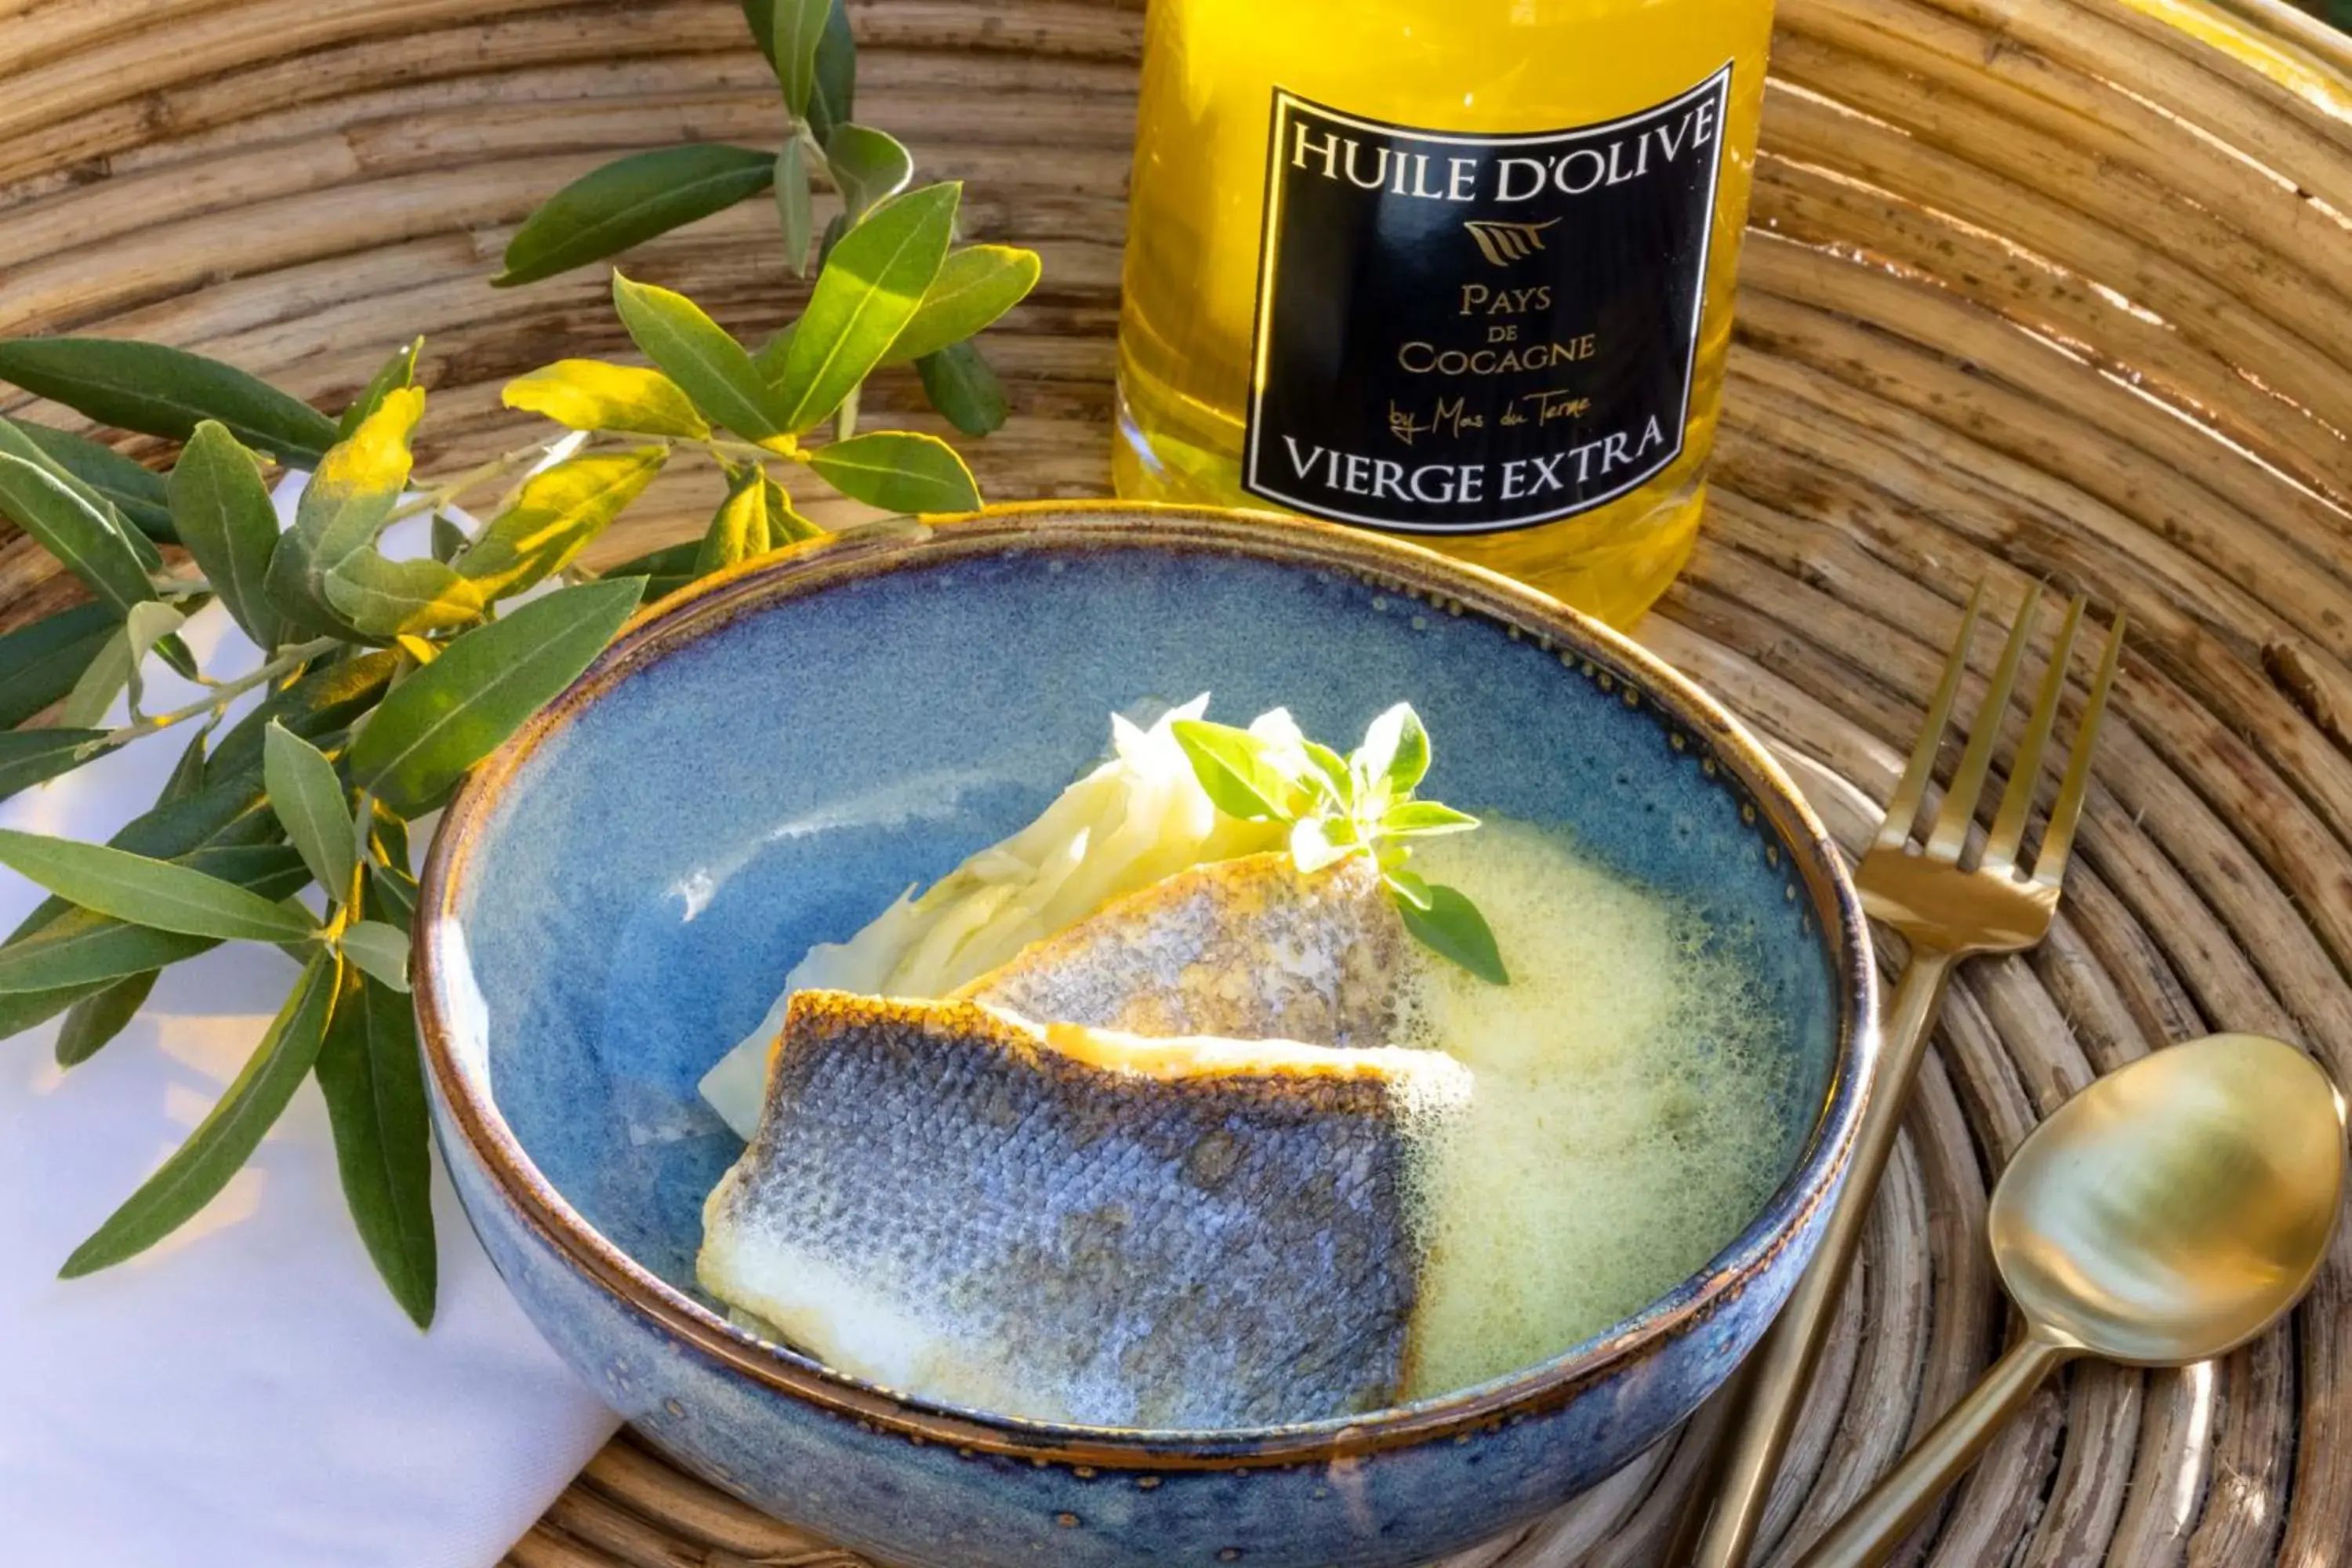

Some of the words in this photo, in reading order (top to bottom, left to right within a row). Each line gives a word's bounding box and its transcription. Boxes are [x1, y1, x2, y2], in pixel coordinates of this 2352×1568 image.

[1292, 122, 1477, 202] HUILE
[1494, 97, 1715, 202] D'OLIVE
[1460, 284, 1551, 315] PAYS
[1398, 333, 1596, 376] COCAGNE
[1487, 325, 1518, 343] DE
[1283, 435, 1485, 503] VIERGE
[1499, 415, 1664, 502] EXTRA
